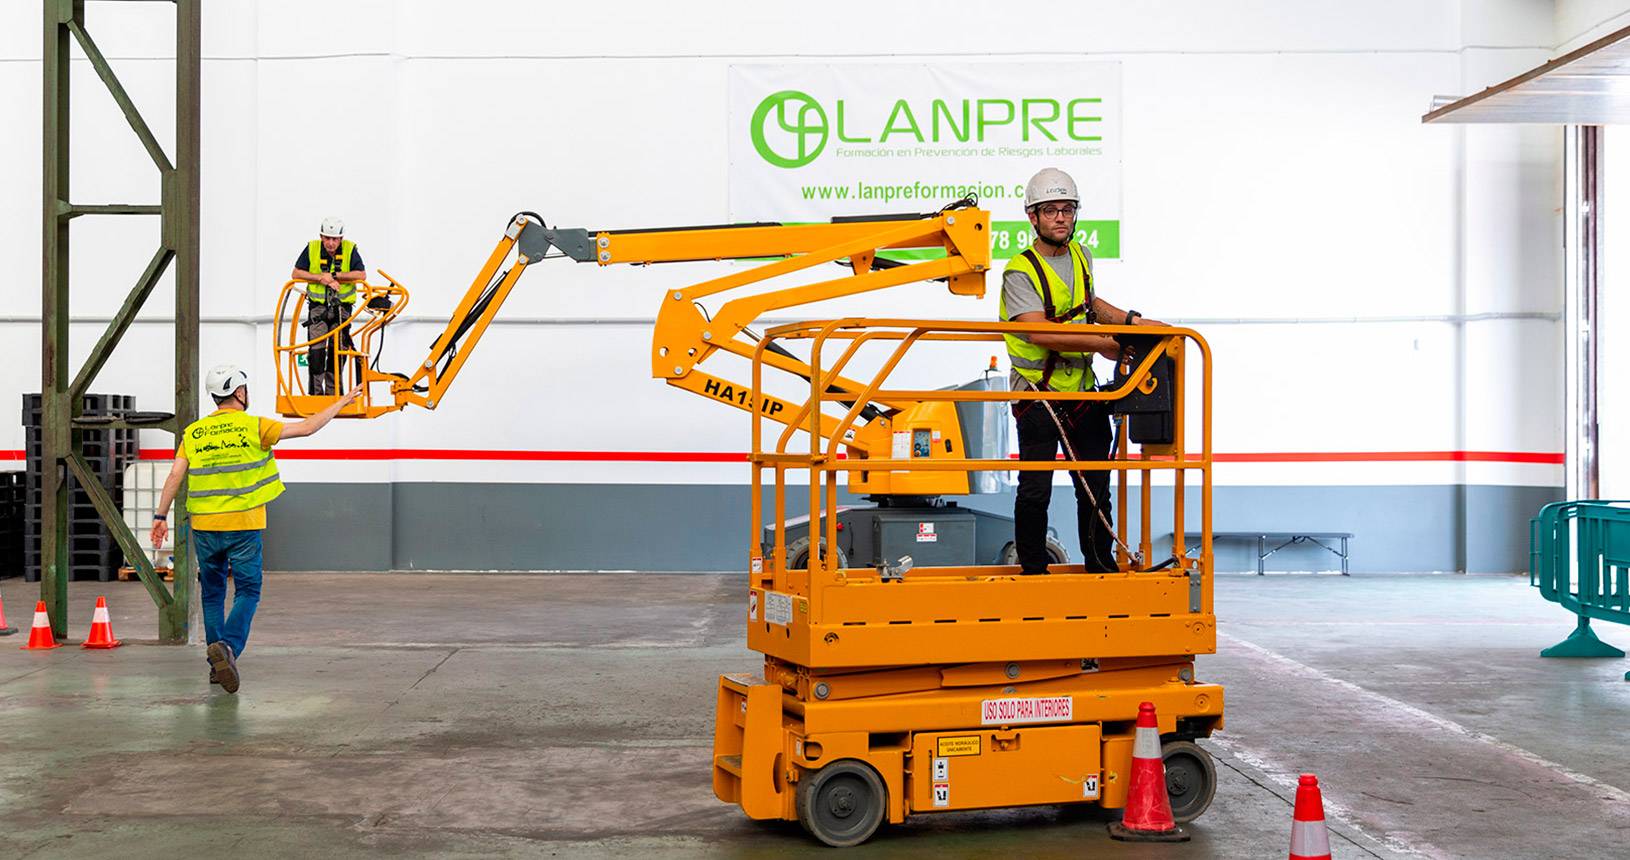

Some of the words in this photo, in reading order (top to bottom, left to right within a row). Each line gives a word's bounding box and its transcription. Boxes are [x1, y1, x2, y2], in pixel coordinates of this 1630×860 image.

[836, 98, 1103, 144] LANPRE
[836, 148, 894, 158] Formación
[897, 149, 912, 157] en
[915, 147, 978, 158] Prevención
[981, 147, 995, 157] de
[998, 146, 1043, 158] Riesgos
[1046, 146, 1103, 157] Laborales
[801, 180, 1025, 203] www.lanpreformacion.c
[984, 701, 998, 720] USO
[999, 700, 1016, 720] SOLO
[1017, 699, 1033, 719] PARA
[1034, 698, 1070, 718] INTERIORES
